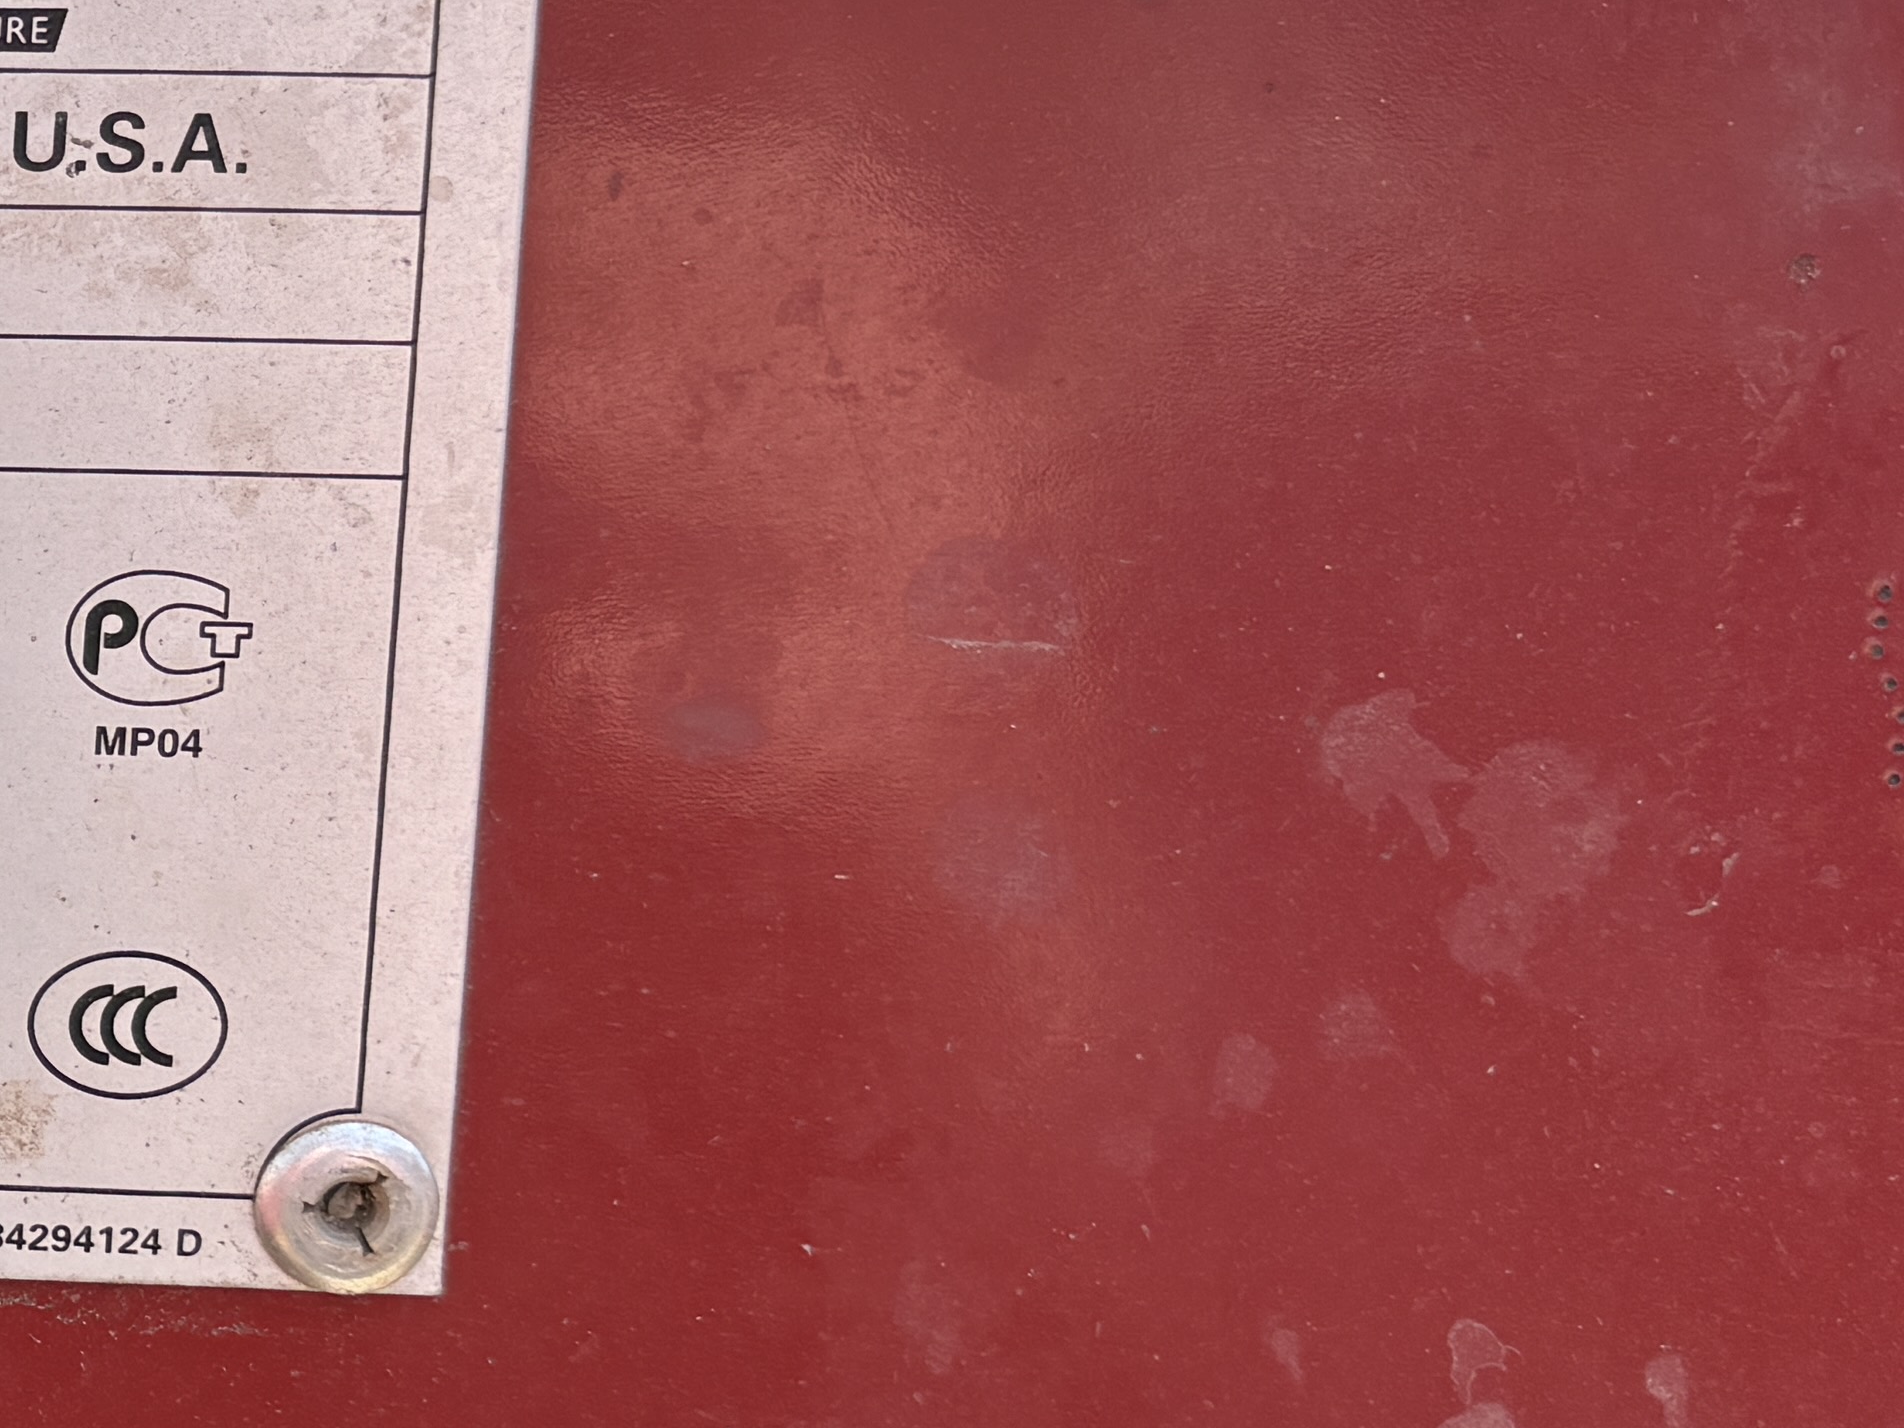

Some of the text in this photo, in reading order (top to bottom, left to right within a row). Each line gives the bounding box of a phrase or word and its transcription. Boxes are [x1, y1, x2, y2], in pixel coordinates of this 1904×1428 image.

[11, 109, 249, 180] U.S.A.
[93, 724, 205, 760] MP04
[175, 1226, 204, 1258] D
